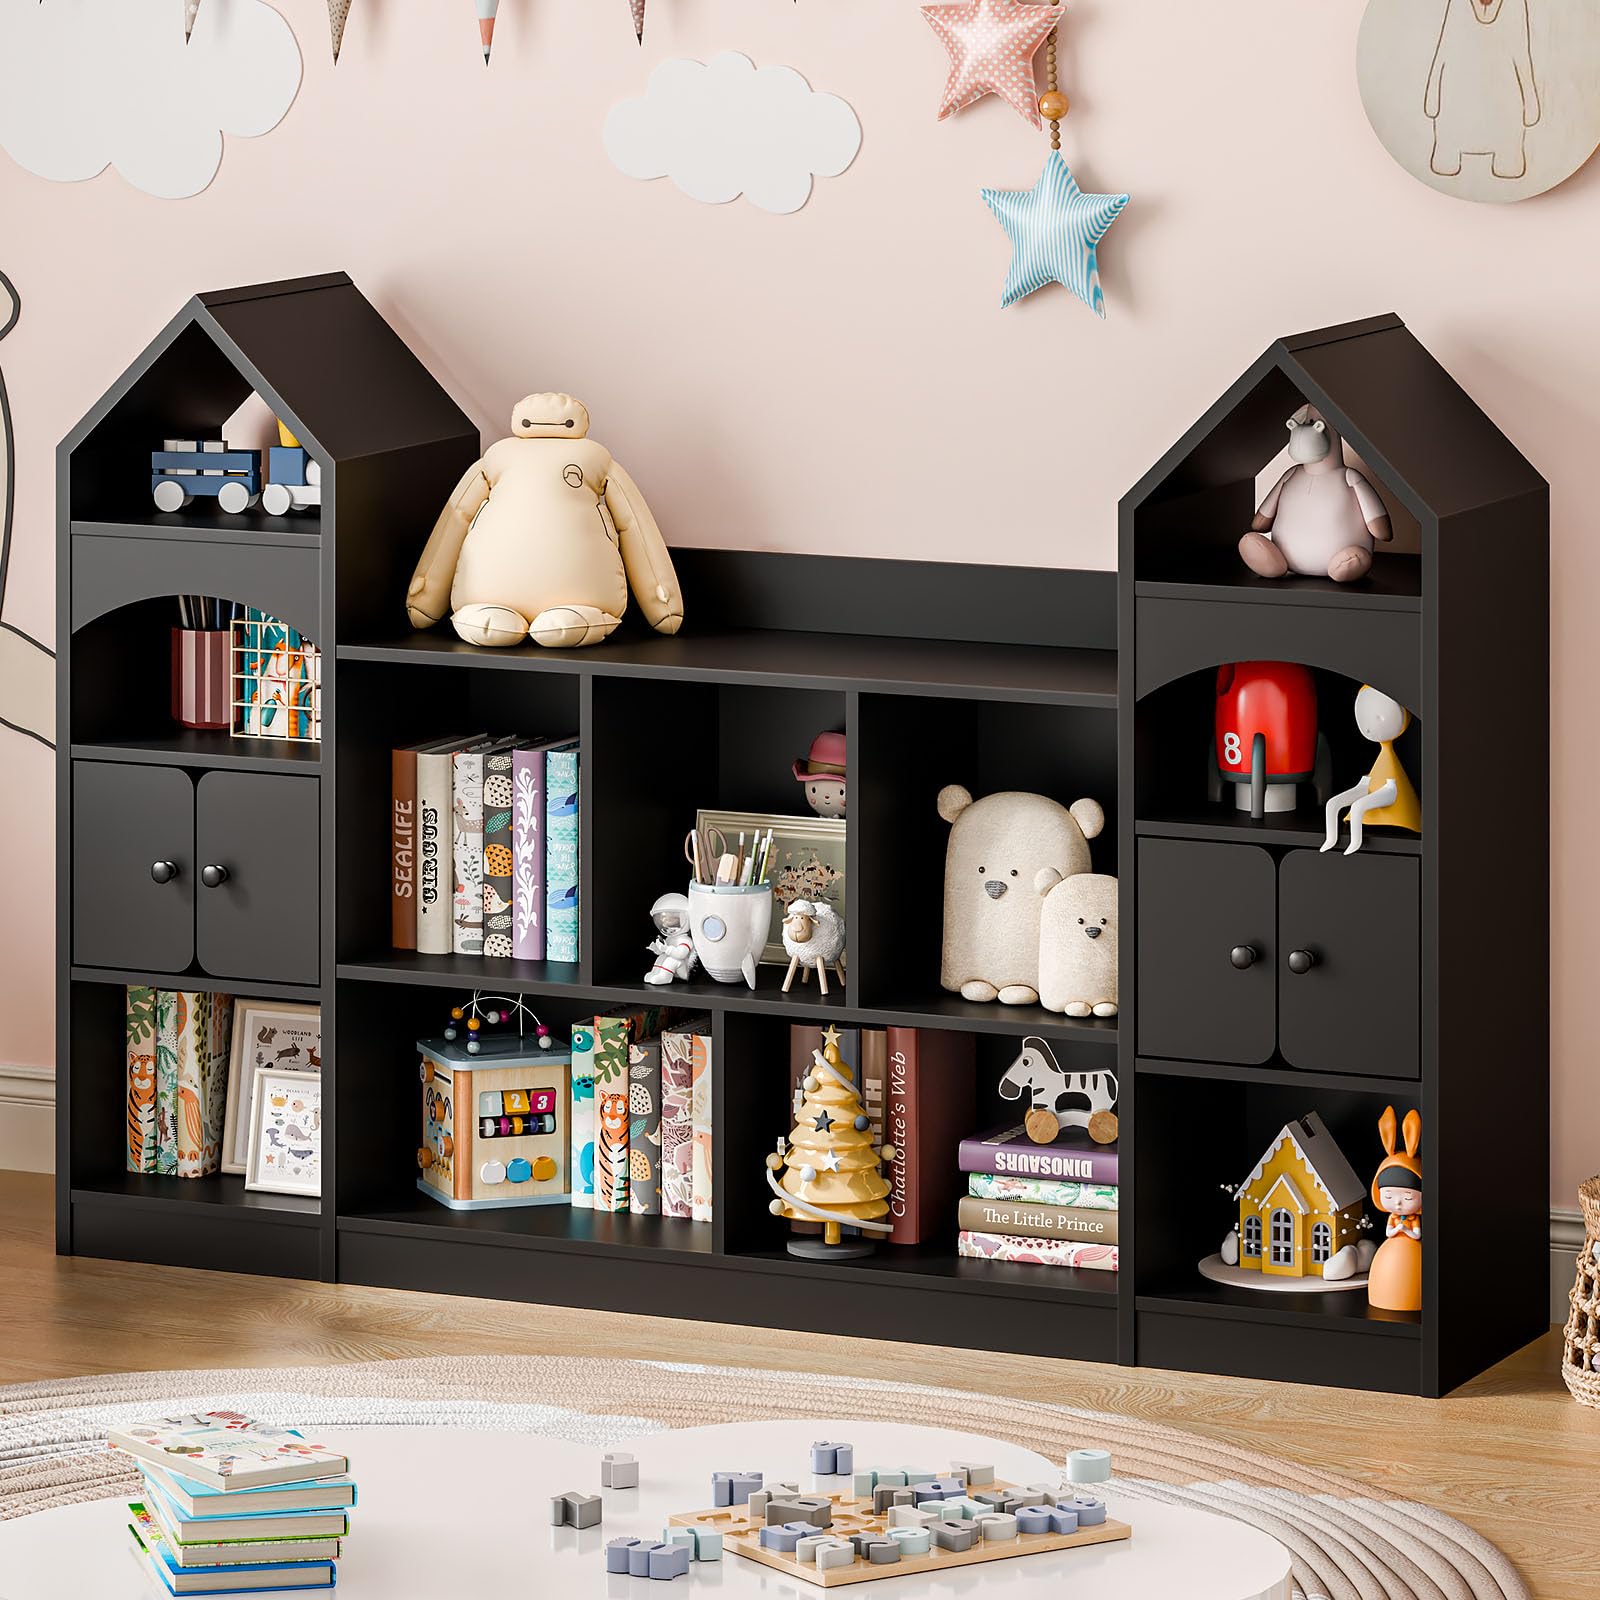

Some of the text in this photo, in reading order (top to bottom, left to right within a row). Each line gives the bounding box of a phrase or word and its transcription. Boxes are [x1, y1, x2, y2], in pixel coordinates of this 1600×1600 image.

[1224, 732, 1242, 765] 8
[395, 799, 413, 898] SEALIFE
[421, 807, 438, 904] CIRCUS
[282, 1029, 312, 1037] WOODLAND
[890, 1051, 906, 1096] Web
[485, 1093, 548, 1113] 1 2 3
[994, 1151, 1094, 1179] DINOSAURS
[982, 1207, 1104, 1233] The Little Prince
